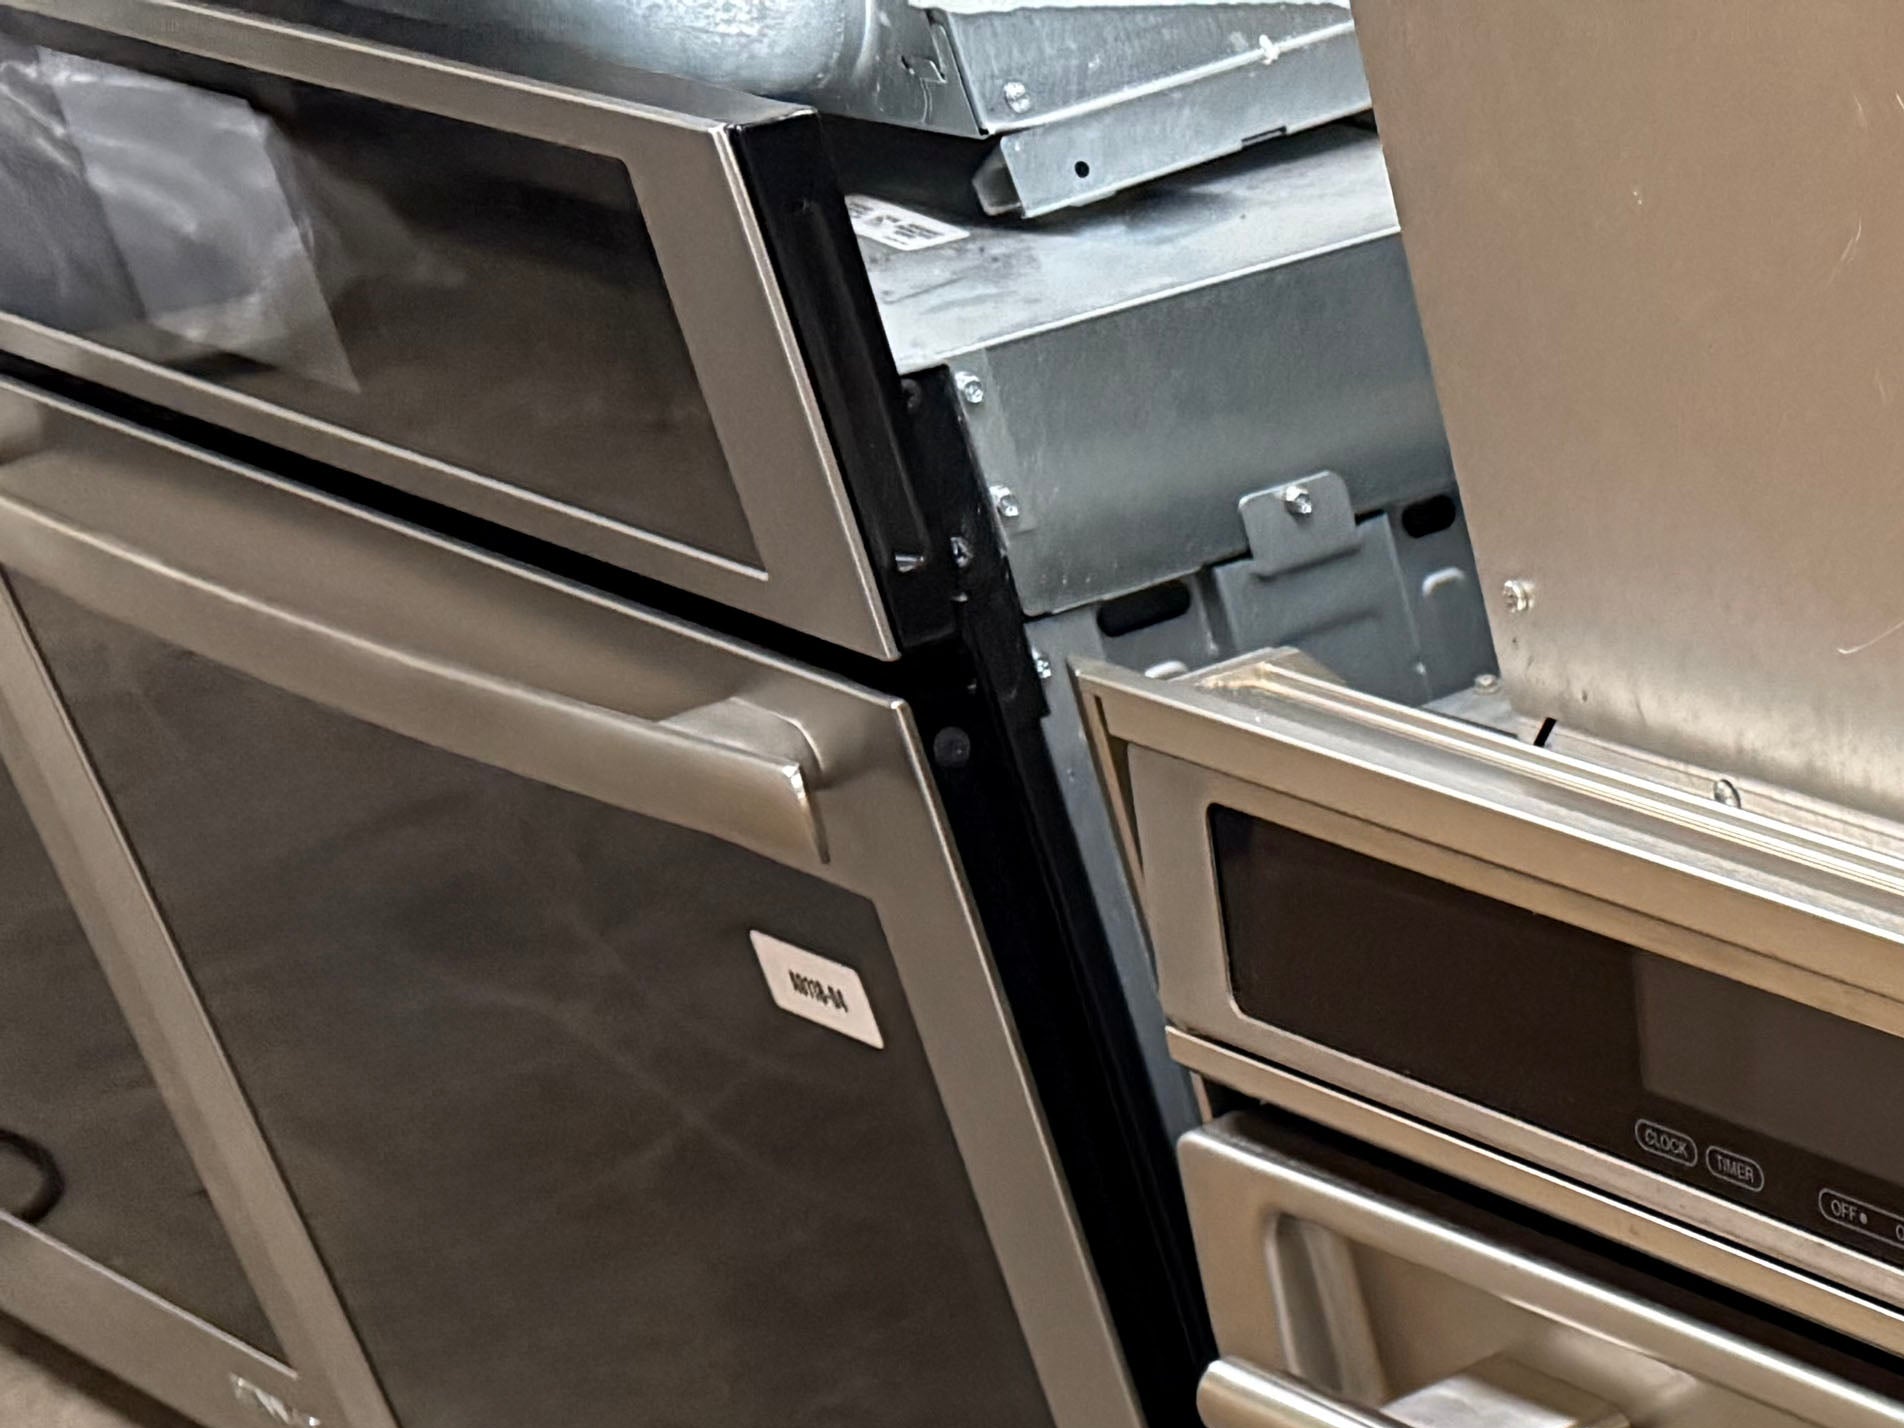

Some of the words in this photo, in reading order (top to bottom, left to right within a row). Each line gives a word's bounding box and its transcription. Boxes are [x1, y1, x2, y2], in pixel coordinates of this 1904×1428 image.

[1644, 1129, 1688, 1157] CLOCK
[1716, 1154, 1754, 1184] TIMER
[1831, 1201, 1858, 1223] OFF
